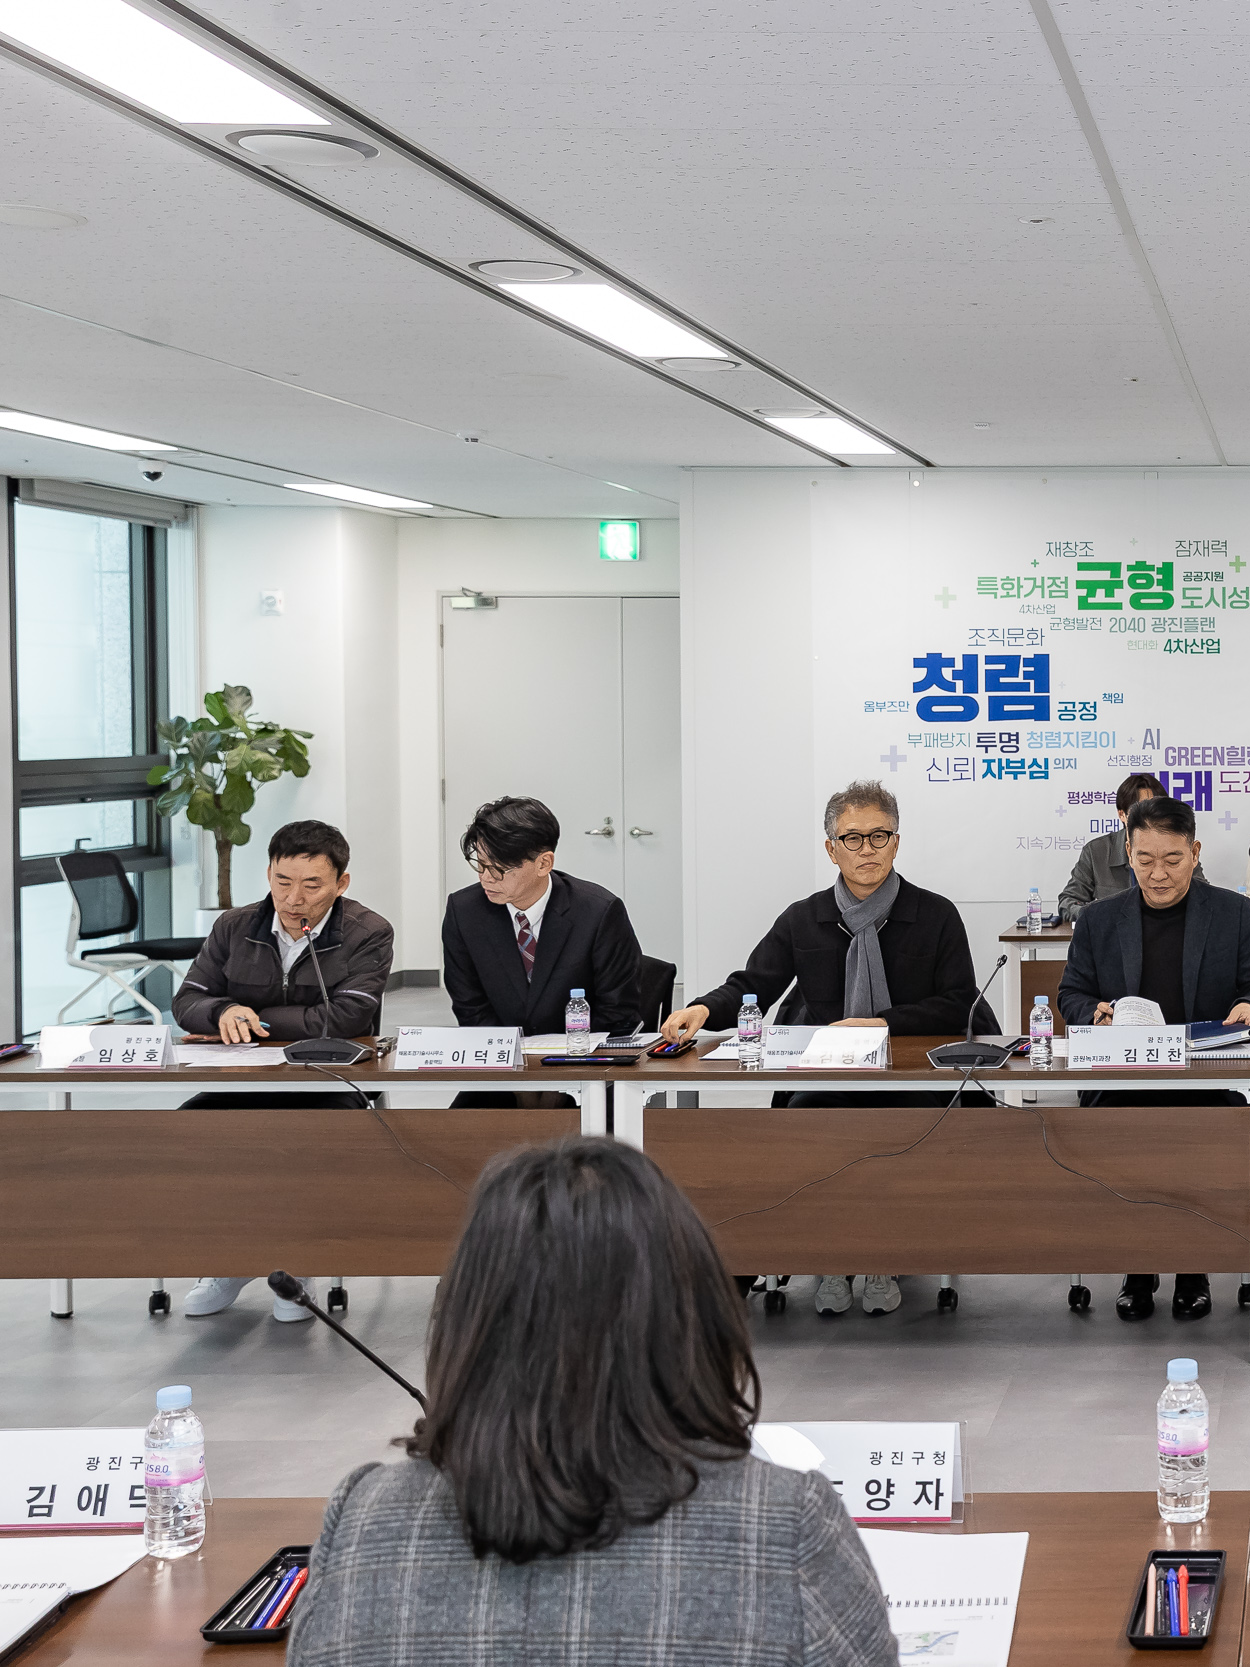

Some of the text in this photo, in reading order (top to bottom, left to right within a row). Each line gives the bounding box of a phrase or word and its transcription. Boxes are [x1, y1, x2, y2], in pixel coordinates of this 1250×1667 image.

[1045, 541, 1095, 558] 재창조
[1174, 540, 1229, 558] 잠재력
[1182, 571, 1224, 582] 공공지원
[976, 576, 1070, 599] 특화거점
[1075, 560, 1175, 611] 균형
[1018, 603, 1056, 615] 4차산업
[1049, 617, 1102, 631] 균형발전
[1109, 616, 1216, 633] 2040 광진플랜
[967, 627, 1045, 647] 조직문화
[1126, 639, 1158, 651] 현대화
[1163, 638, 1221, 655] 4차산업
[912, 652, 1051, 723] 청렴
[863, 701, 910, 712] 옴부즈만
[1102, 692, 1124, 704] 책임
[1057, 701, 1097, 721] 공정
[907, 731, 1116, 754] 부패방지 투명 청렴지킴이
[1141, 728, 1161, 750] AI
[926, 757, 1078, 782] 신뢰 자부심 의지
[1107, 755, 1153, 767] 선진행정
[99, 1048, 159, 1063] 임상호
[451, 1049, 511, 1065] 이덕희
[1124, 1048, 1182, 1063] 김진찬
[869, 1451, 946, 1465] 광진구청
[832, 1477, 944, 1511] 양자
